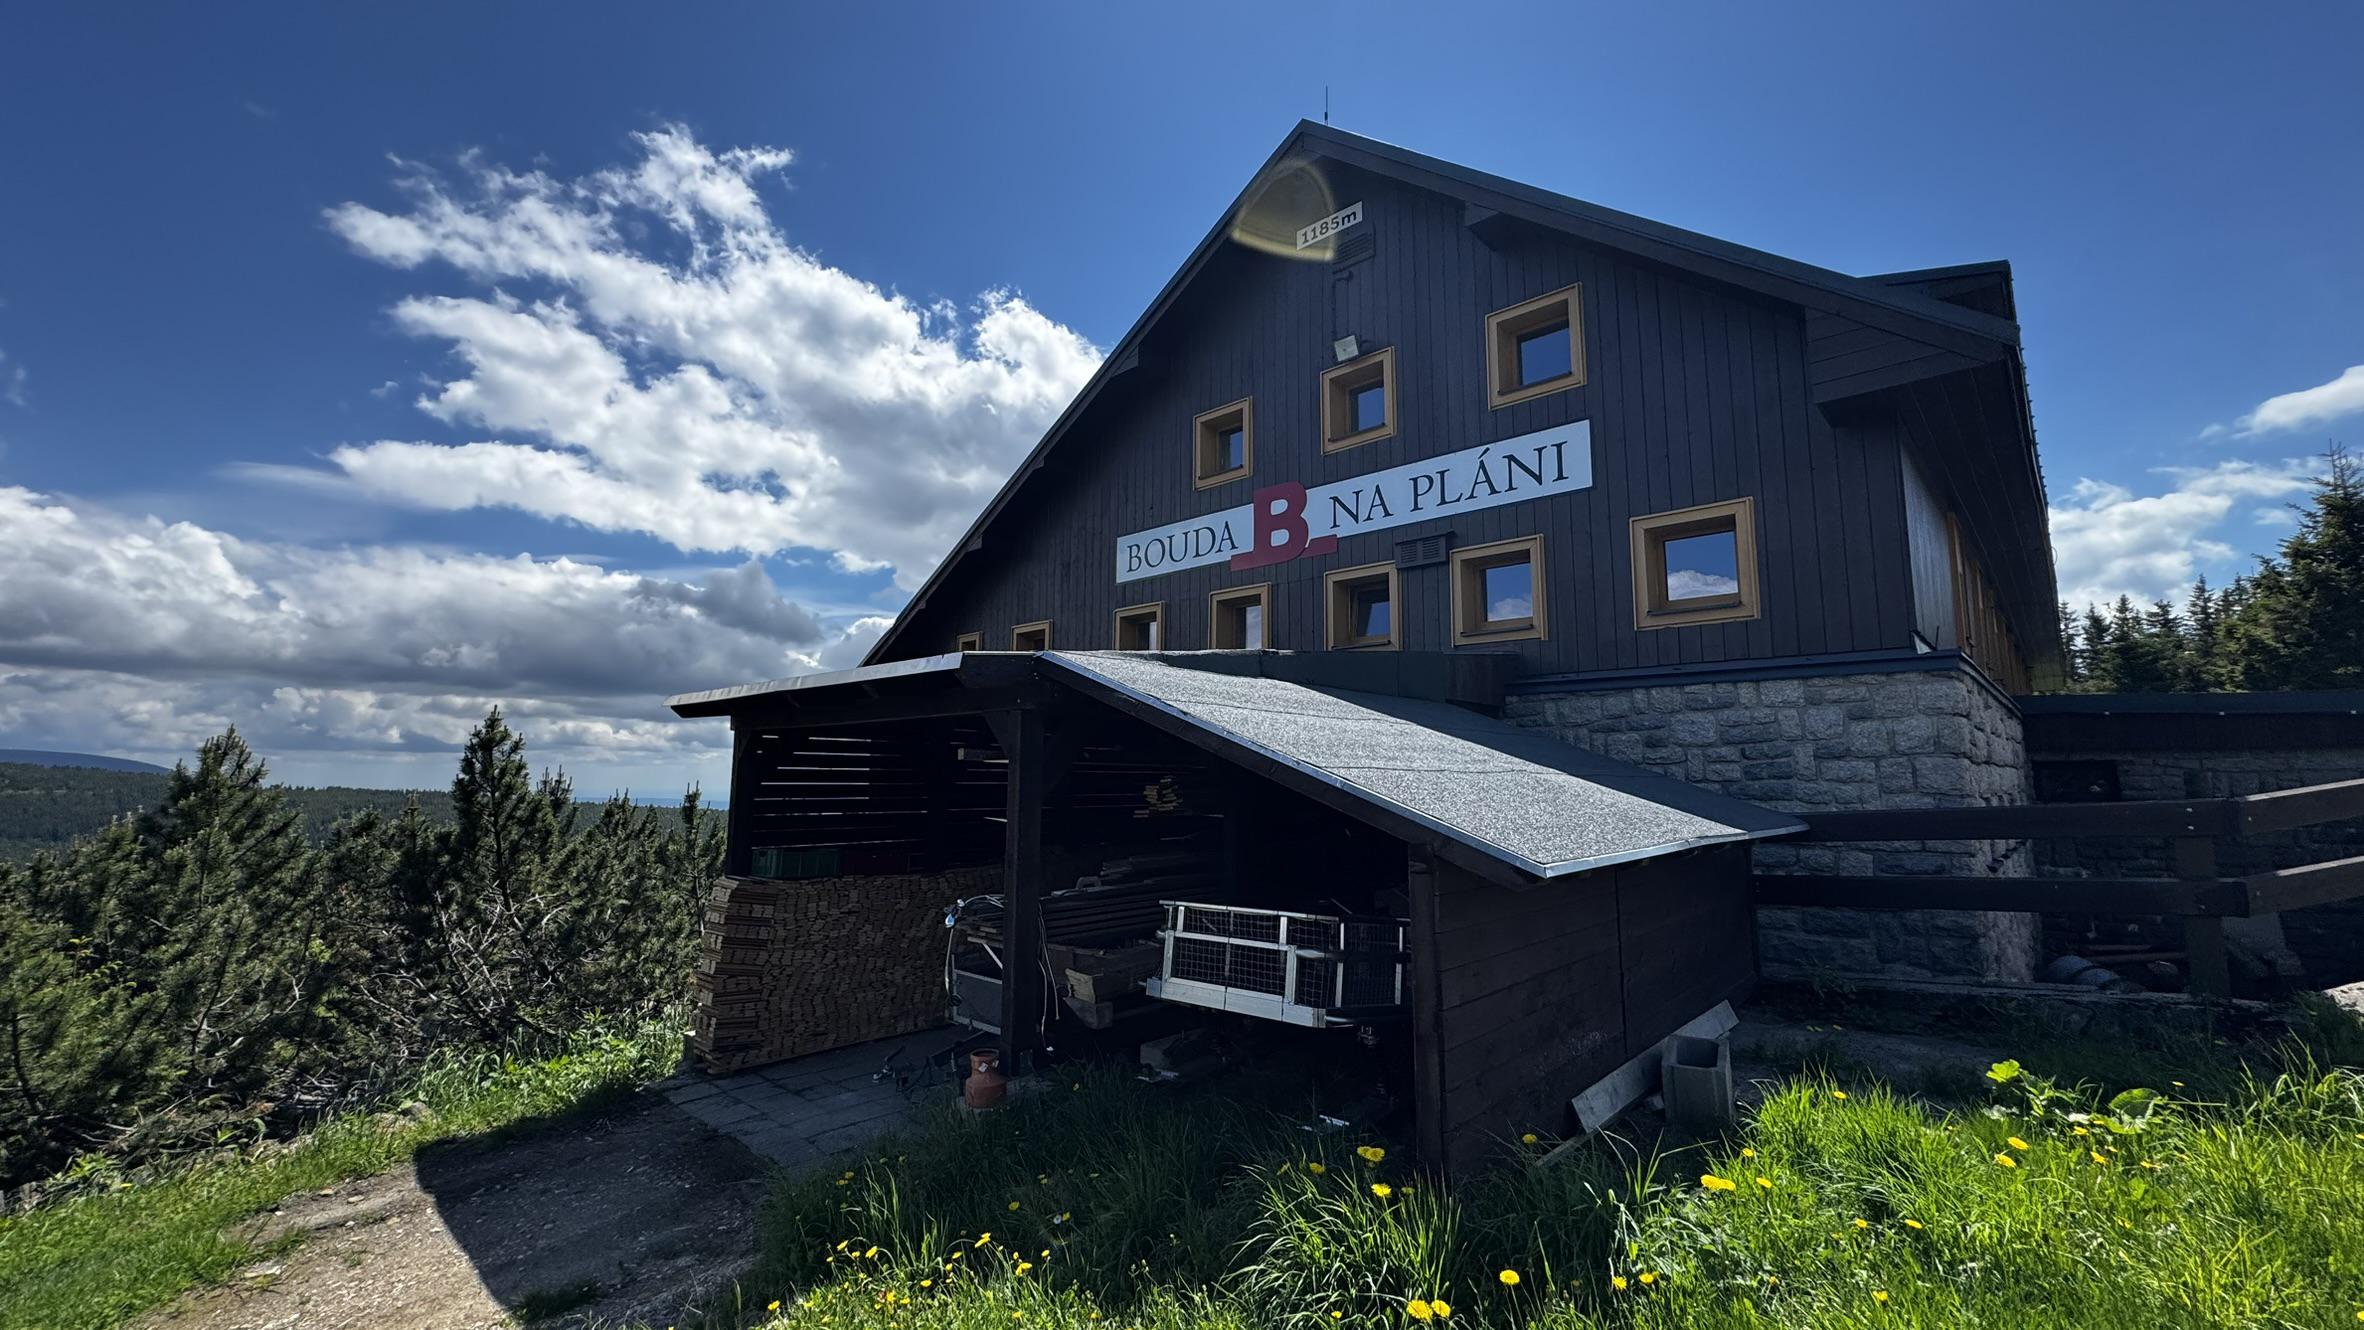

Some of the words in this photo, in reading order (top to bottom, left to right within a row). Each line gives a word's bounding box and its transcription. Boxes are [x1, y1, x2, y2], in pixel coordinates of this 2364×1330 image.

[1302, 211, 1357, 245] 1185m
[1126, 520, 1239, 573] BOUDA
[1231, 481, 1338, 571] B
[1329, 484, 1394, 529] NA
[1408, 440, 1570, 513] PLÁNI
